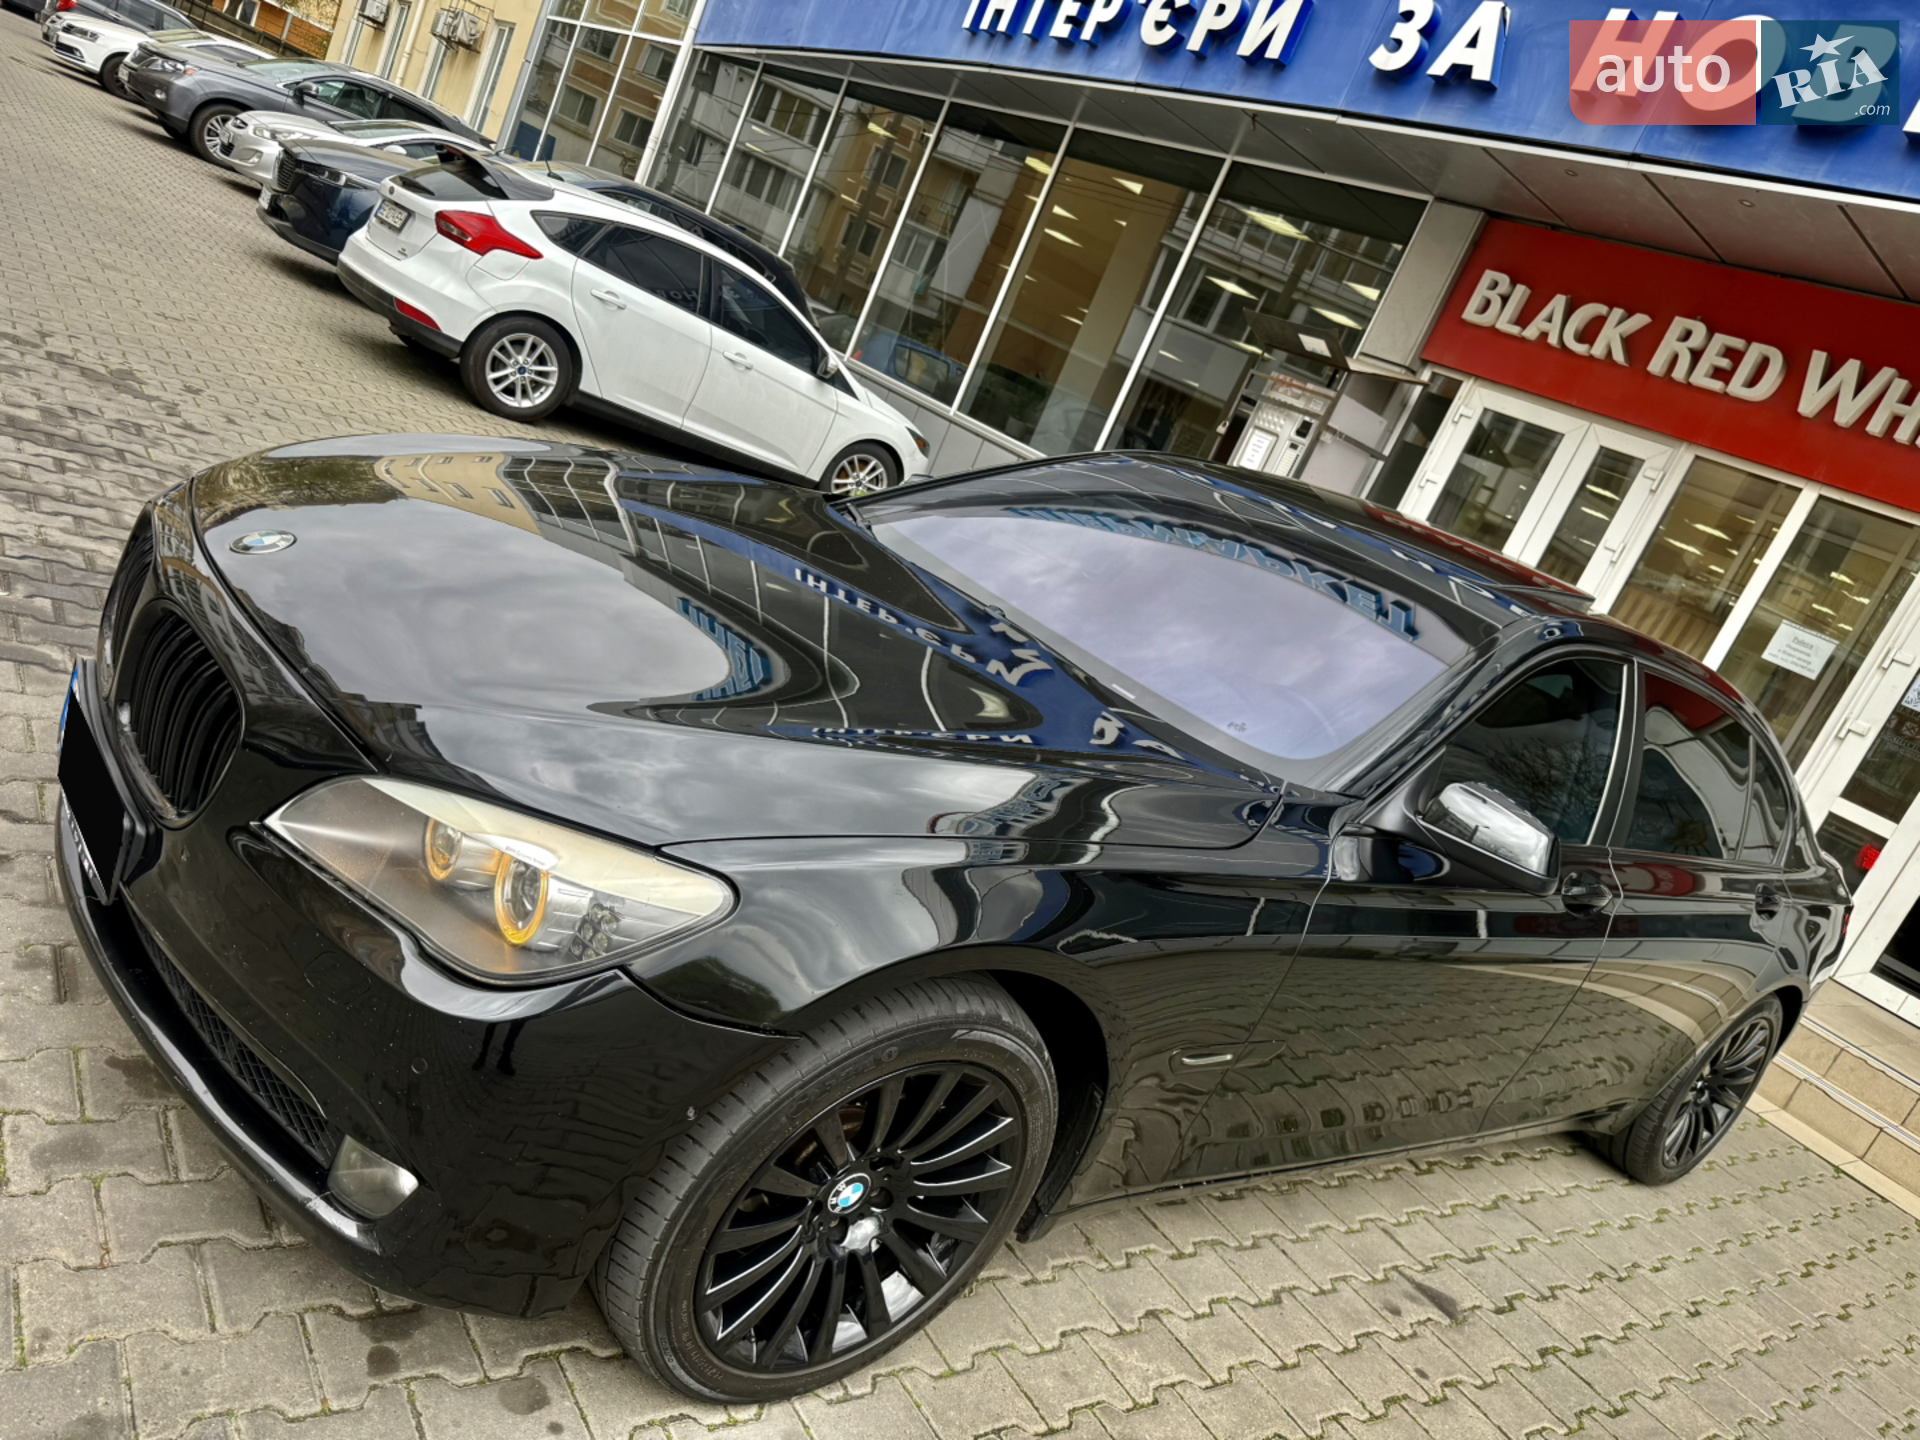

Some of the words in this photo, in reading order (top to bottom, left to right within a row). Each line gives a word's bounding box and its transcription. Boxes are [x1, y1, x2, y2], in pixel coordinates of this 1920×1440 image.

[1368, 0, 1503, 84] ЗА
[1571, 8, 1920, 141] НОВ
[1461, 269, 1652, 367] BLACK
[1646, 316, 1787, 402] RED
[1797, 349, 1920, 447] WH
